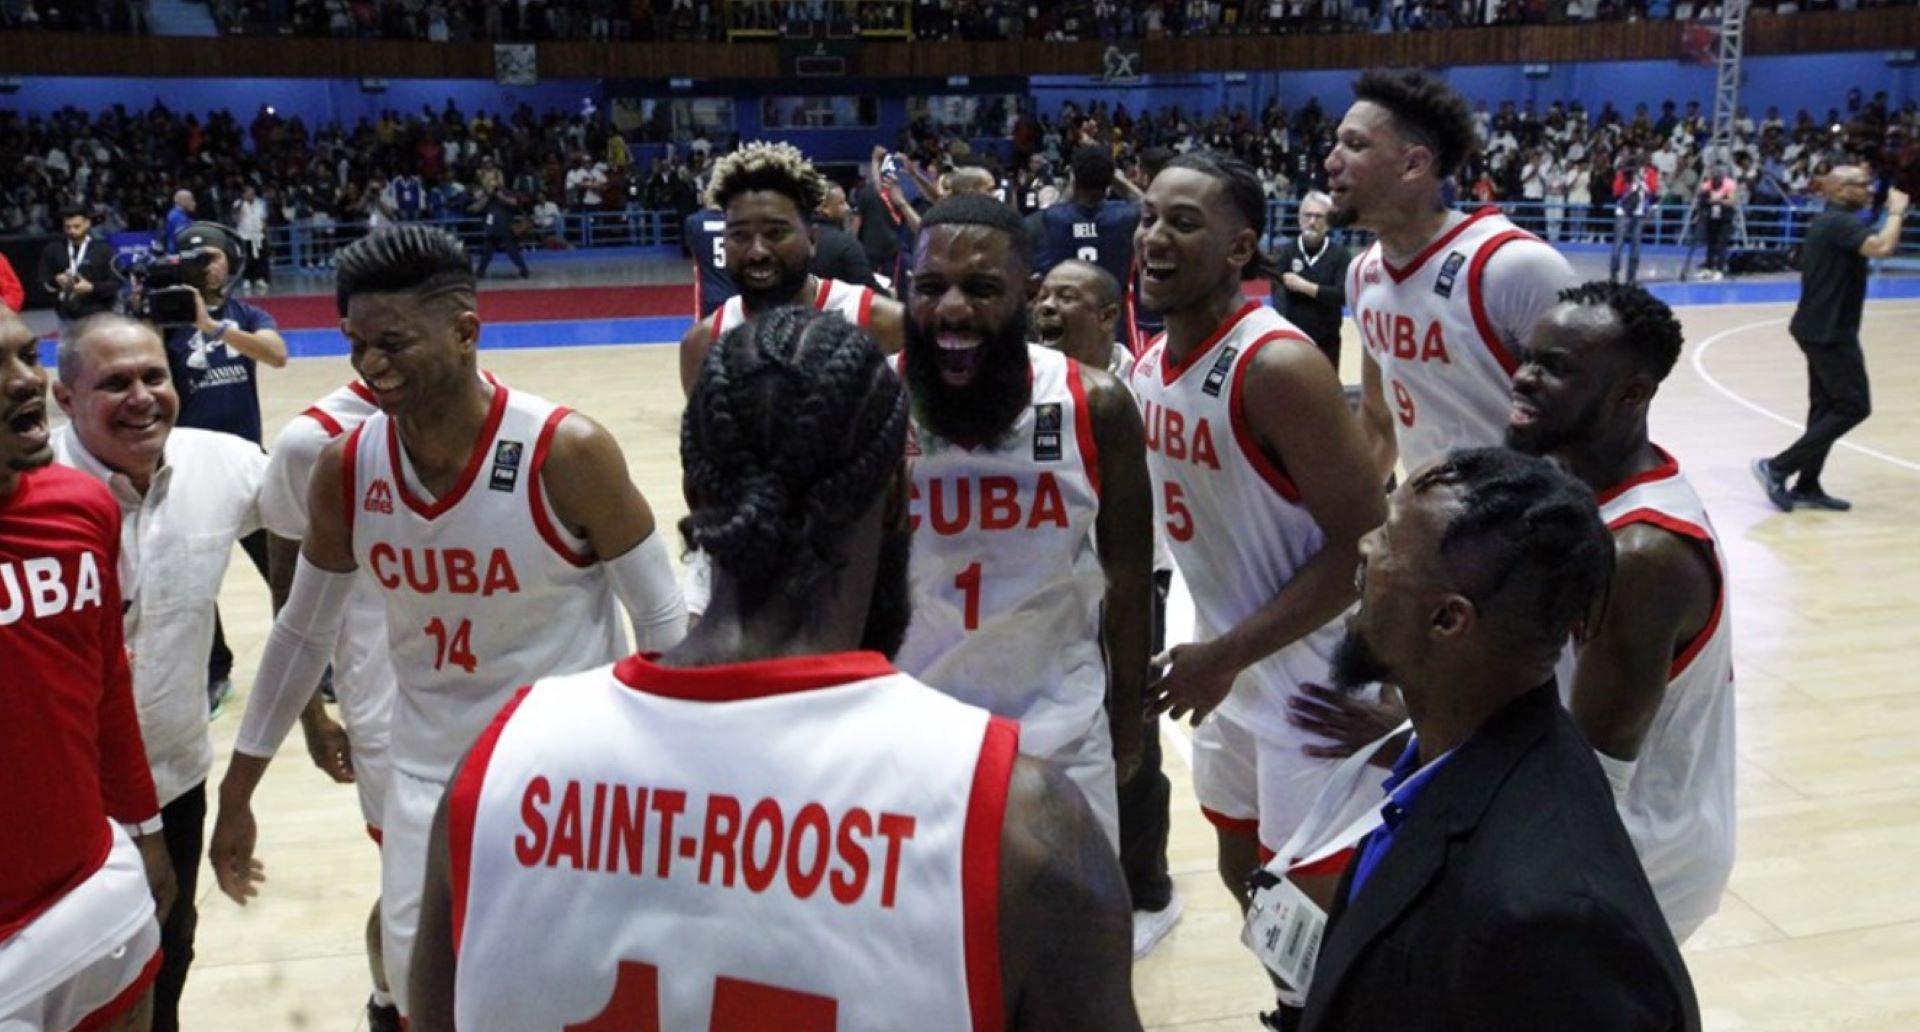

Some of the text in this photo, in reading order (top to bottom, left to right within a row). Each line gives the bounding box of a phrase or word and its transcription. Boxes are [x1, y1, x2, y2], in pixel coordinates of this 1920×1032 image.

[1362, 308, 1451, 364] CUBA
[1392, 379, 1415, 427] 9
[1163, 481, 1195, 542] 5
[369, 541, 520, 597] CUBA
[955, 561, 983, 631] 1
[424, 616, 477, 674] 14
[514, 776, 917, 908] SAINT-ROOST
